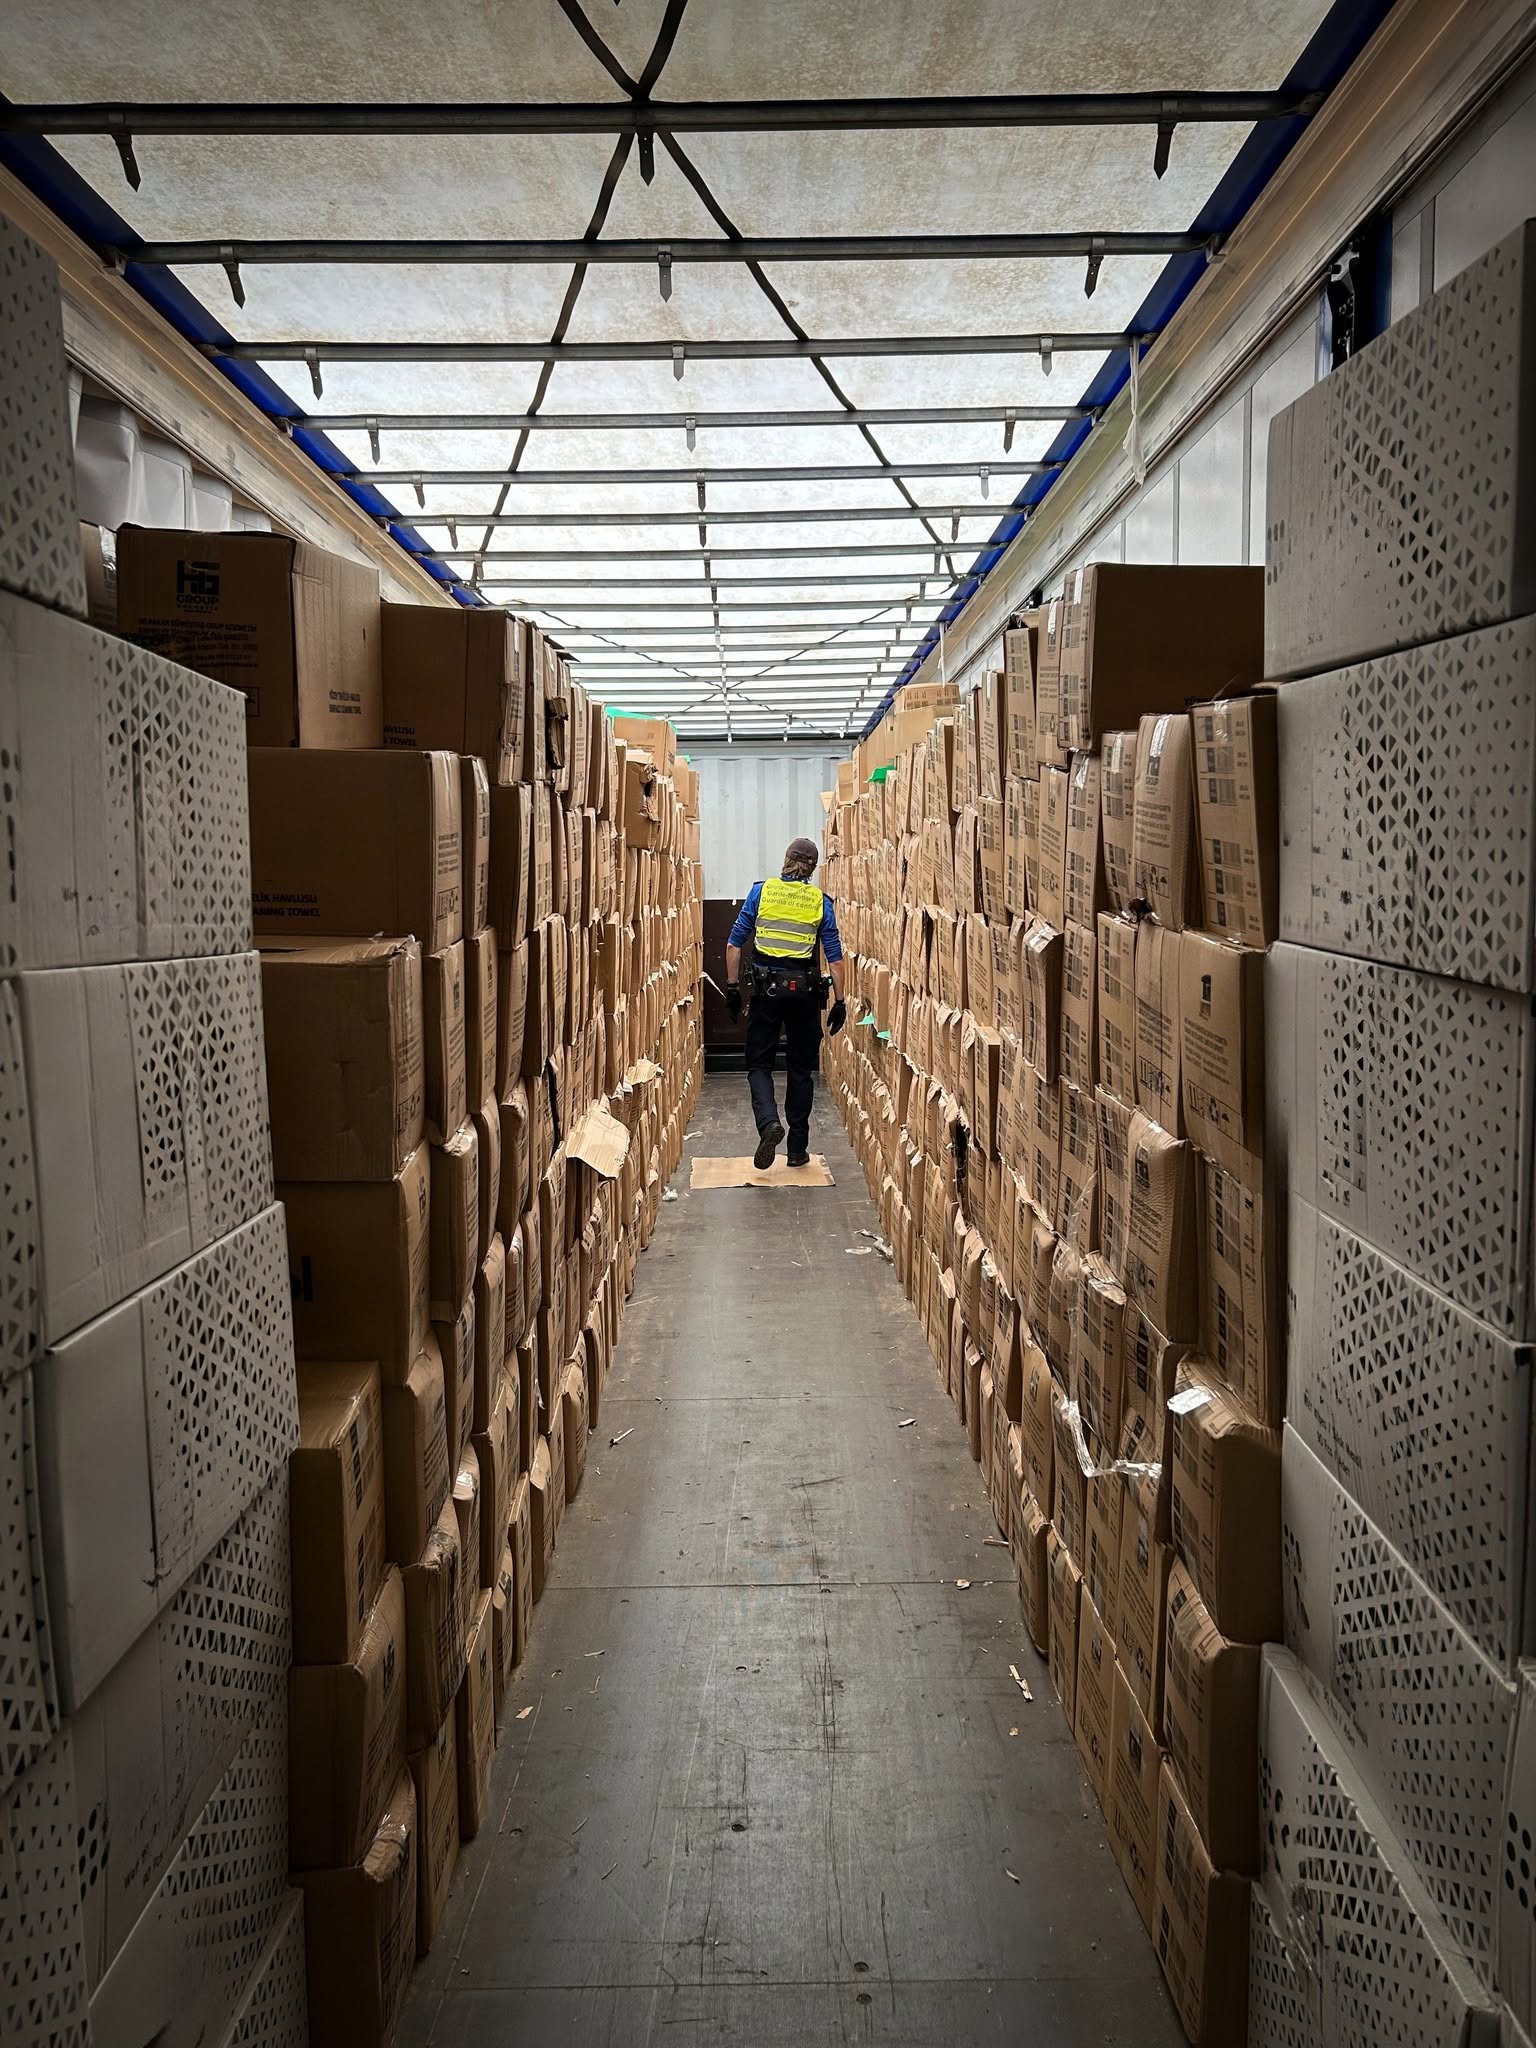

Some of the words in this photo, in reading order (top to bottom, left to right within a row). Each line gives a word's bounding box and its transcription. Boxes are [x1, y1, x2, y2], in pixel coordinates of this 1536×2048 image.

[176, 594, 220, 605] GROUP
[383, 725, 415, 735] AVLUSU
[390, 737, 417, 746] TOWEL
[272, 893, 318, 904] HAVLUSU
[761, 896, 787, 906] Guardia
[252, 906, 286, 917] ANING
[287, 907, 321, 917] TOWEL
